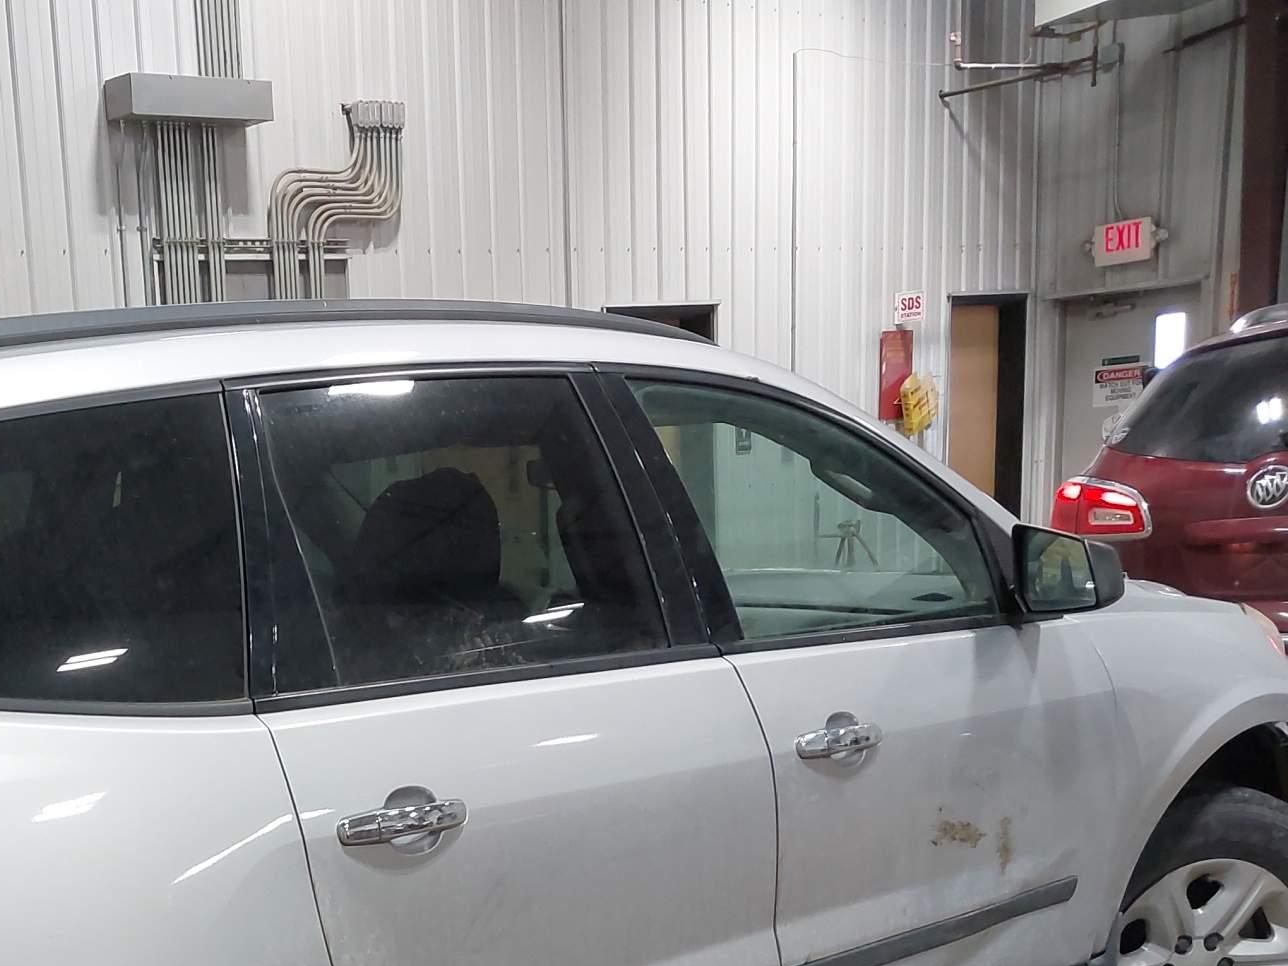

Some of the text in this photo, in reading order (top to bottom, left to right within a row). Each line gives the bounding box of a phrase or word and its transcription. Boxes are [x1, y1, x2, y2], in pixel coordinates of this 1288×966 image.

[1105, 221, 1143, 252] EXIT
[900, 295, 922, 312] SDS
[1102, 368, 1143, 380] DANGER
